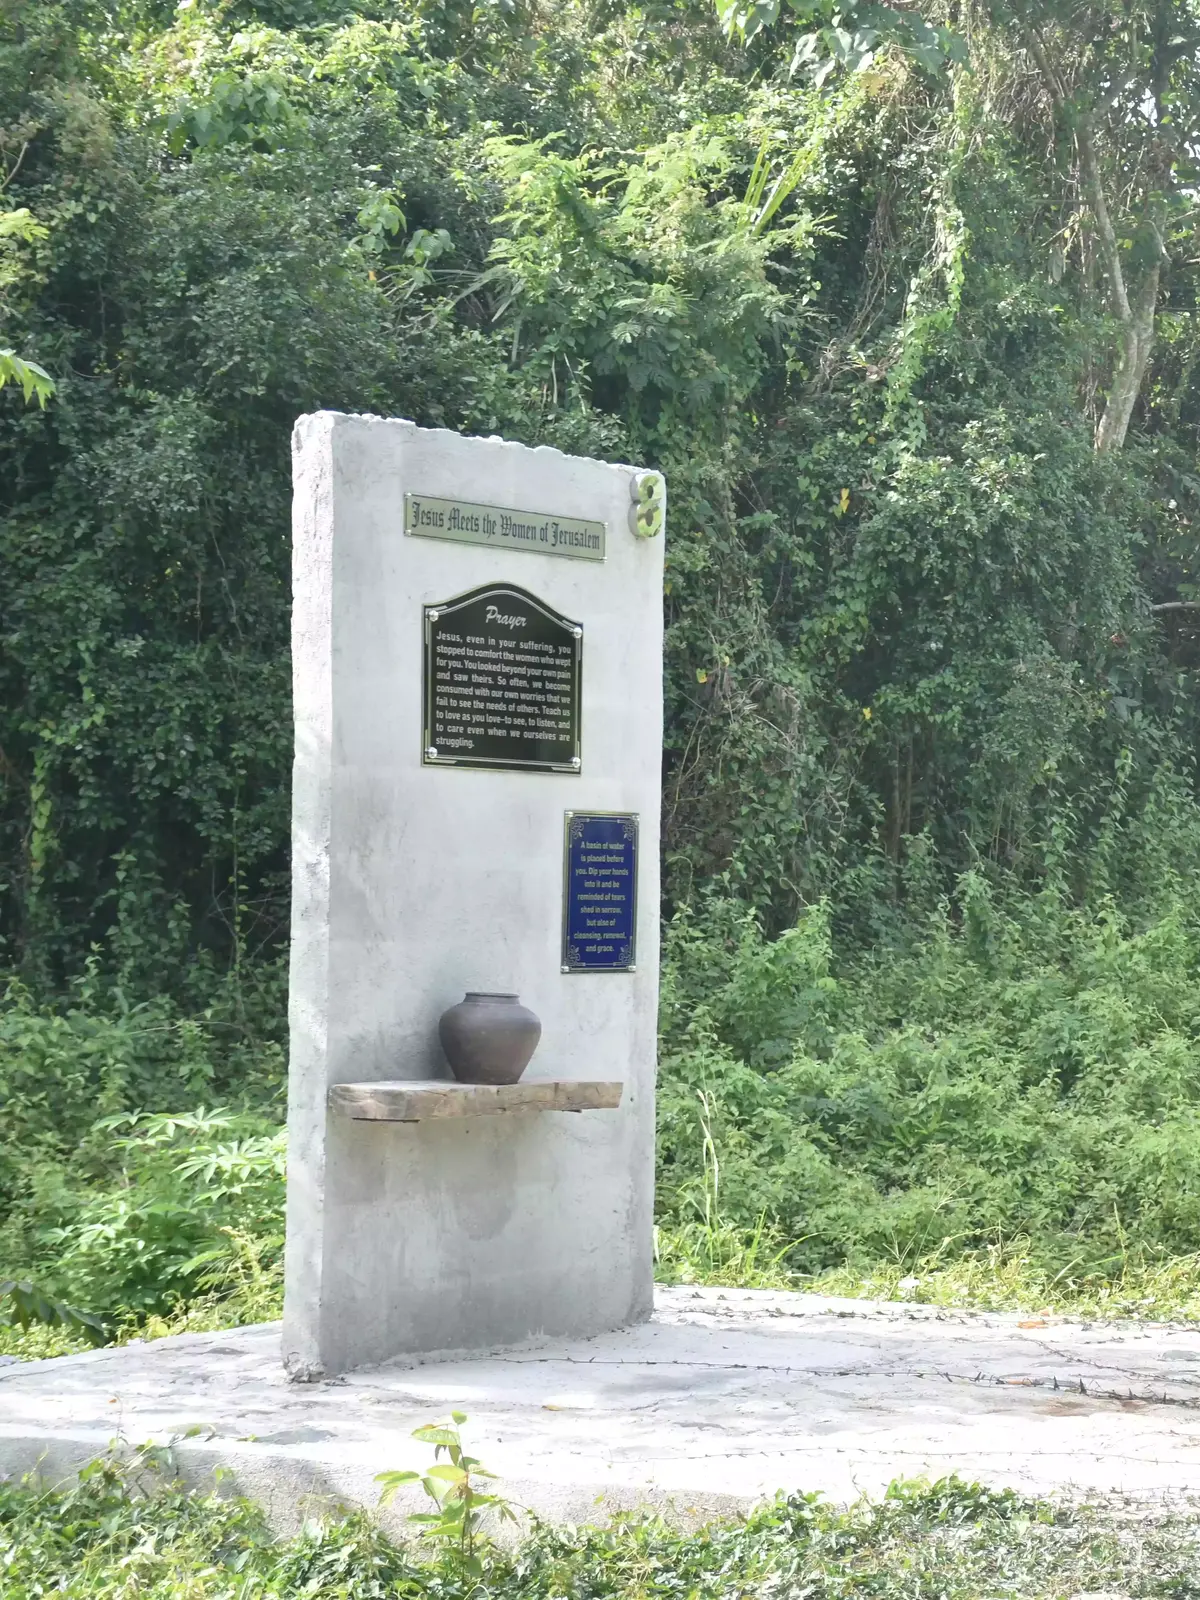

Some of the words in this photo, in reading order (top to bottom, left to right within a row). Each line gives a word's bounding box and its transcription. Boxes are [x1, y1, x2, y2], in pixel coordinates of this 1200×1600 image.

[634, 474, 662, 538] 8
[412, 502, 444, 528] Jesus
[448, 508, 479, 532] Meets
[483, 514, 496, 538] the
[501, 515, 536, 540] Women
[540, 523, 548, 542] of
[551, 522, 600, 550] Jerusalem
[486, 606, 527, 629] Prayer
[436, 631, 463, 642] Jesus,
[466, 635, 484, 644] even
[488, 636, 495, 645] in
[499, 638, 516, 648] your
[520, 641, 555, 653] suffering,
[558, 646, 571, 654] you
[437, 645, 465, 656] stopped
[475, 649, 502, 659] comfort
[503, 651, 514, 660] the
[515, 654, 539, 663] women
[541, 655, 554, 664] who
[555, 657, 571, 667] wept
[436, 658, 446, 666] for
[448, 661, 463, 669] you.
[478, 662, 500, 671] looked
[502, 664, 526, 675] beyond
[543, 669, 556, 677] own
[557, 671, 571, 679] pain
[437, 671, 450, 679] and
[472, 674, 494, 683] theirs.
[498, 676, 506, 685] So
[510, 678, 529, 688] often,
[545, 681, 570, 691] become
[437, 685, 473, 695] consumed
[475, 687, 489, 696] with
[520, 692, 545, 701] worries
[547, 694, 559, 702] that
[436, 697, 448, 705] fail
[450, 698, 457, 706] to
[459, 700, 471, 708] see
[473, 699, 484, 708] the
[486, 701, 506, 711] needs
[517, 704, 540, 713] others.
[542, 705, 561, 715] Teach
[562, 708, 570, 716] us
[445, 711, 460, 720] love
[462, 712, 470, 720] as
[472, 714, 485, 723] you
[513, 717, 527, 726] see,
[529, 718, 535, 726] to
[537, 717, 557, 728] listen,
[558, 720, 570, 728] and
[436, 723, 443, 731] to
[488, 727, 506, 736] when
[524, 731, 556, 740] ourselves
[436, 737, 474, 748] struggling.
